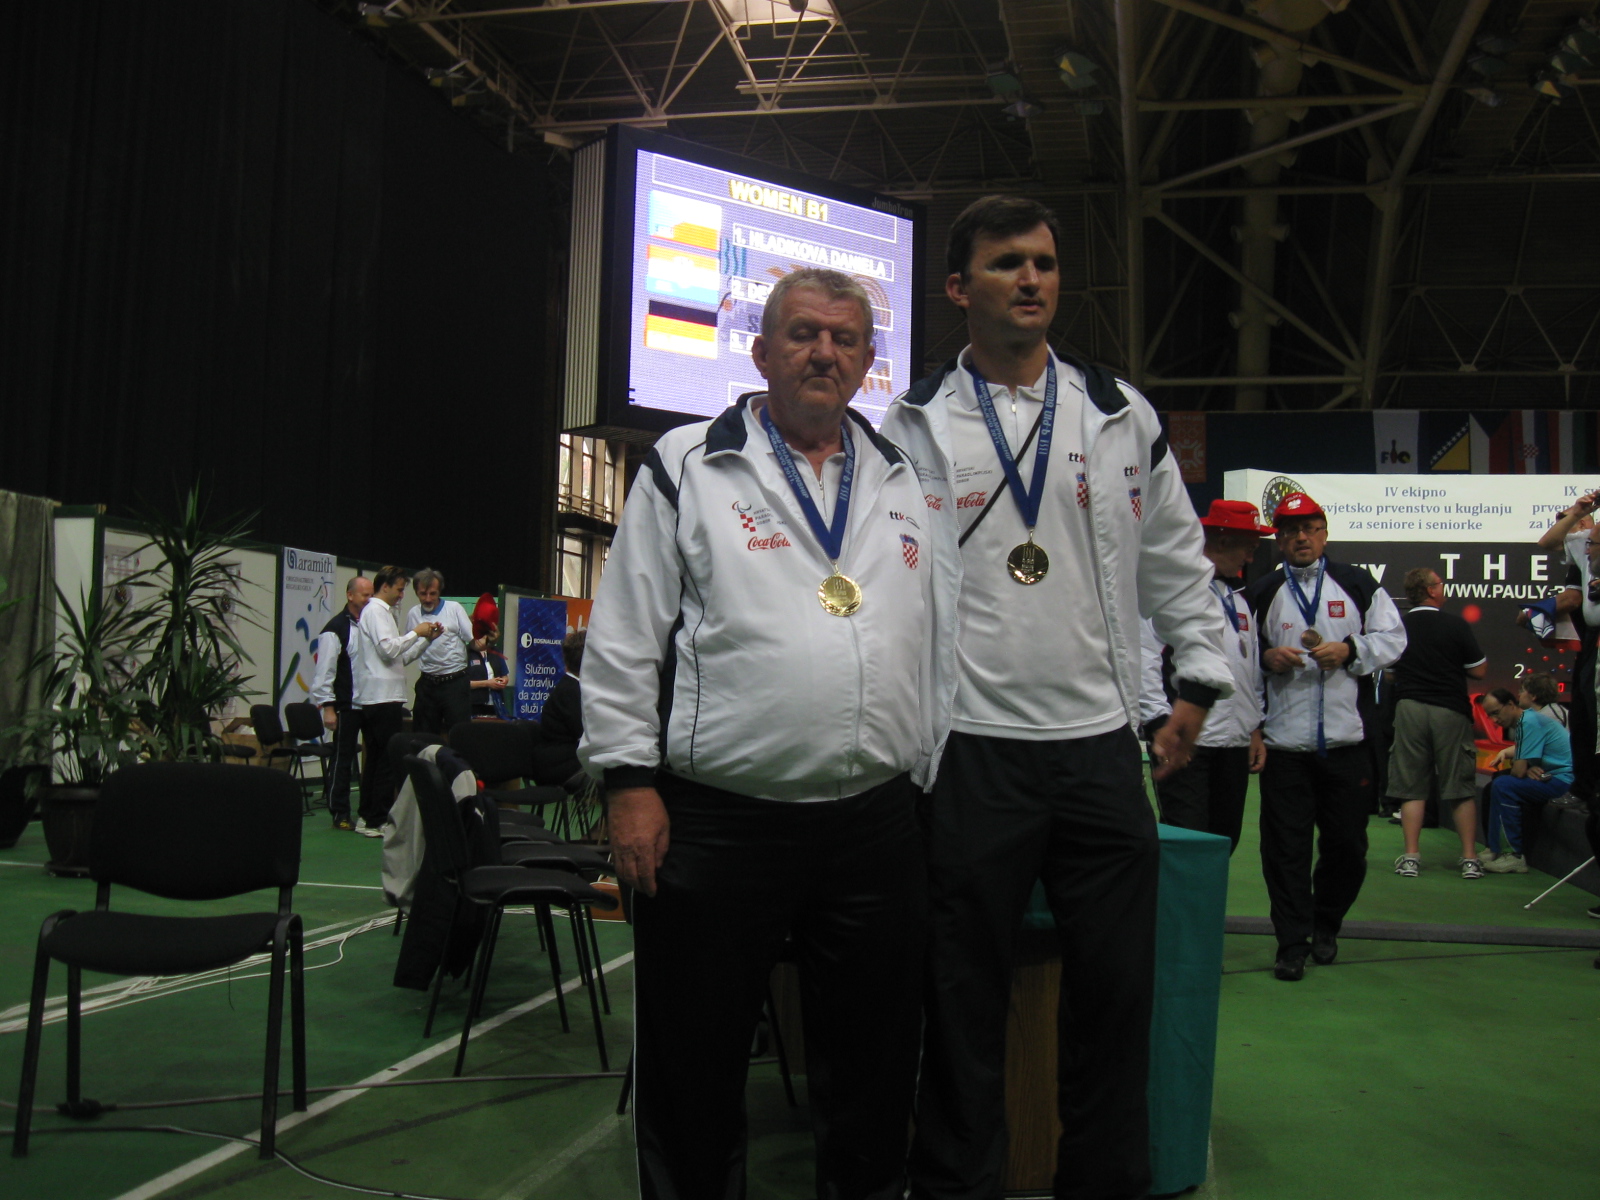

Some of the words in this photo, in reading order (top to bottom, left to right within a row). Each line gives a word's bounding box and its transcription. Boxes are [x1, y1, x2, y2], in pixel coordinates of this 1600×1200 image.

[729, 179, 803, 215] WOMEN
[805, 199, 829, 222] B1
[871, 196, 913, 218] JumboTron
[831, 250, 887, 277] DANIELA
[988, 406, 1013, 462] CHAMPIONSHIP
[770, 425, 783, 444] WORLD
[778, 443, 810, 499] CHAMPIONSHIP
[1068, 452, 1086, 464] ttk
[1124, 466, 1140, 477] ttk
[1385, 487, 1398, 497] IV
[1402, 486, 1447, 500] ekipno
[1564, 486, 1577, 497] IX
[889, 510, 905, 521] ttk
[1322, 503, 1372, 515] svjetsko
[1376, 503, 1441, 516] prvenstvo
[1444, 505, 1452, 514] u
[1456, 503, 1512, 517] kuglanju
[1349, 522, 1363, 530] za
[1367, 520, 1415, 530] seniore
[1418, 519, 1422, 529] i
[1425, 519, 1483, 530] seniorke
[1529, 520, 1543, 529] za
[298, 557, 333, 574] aramith
[524, 663, 556, 675] Služimo
[1513, 663, 1525, 679] 2
[518, 690, 529, 700] da
[530, 690, 550, 700] zdra
[520, 702, 539, 714] služi
